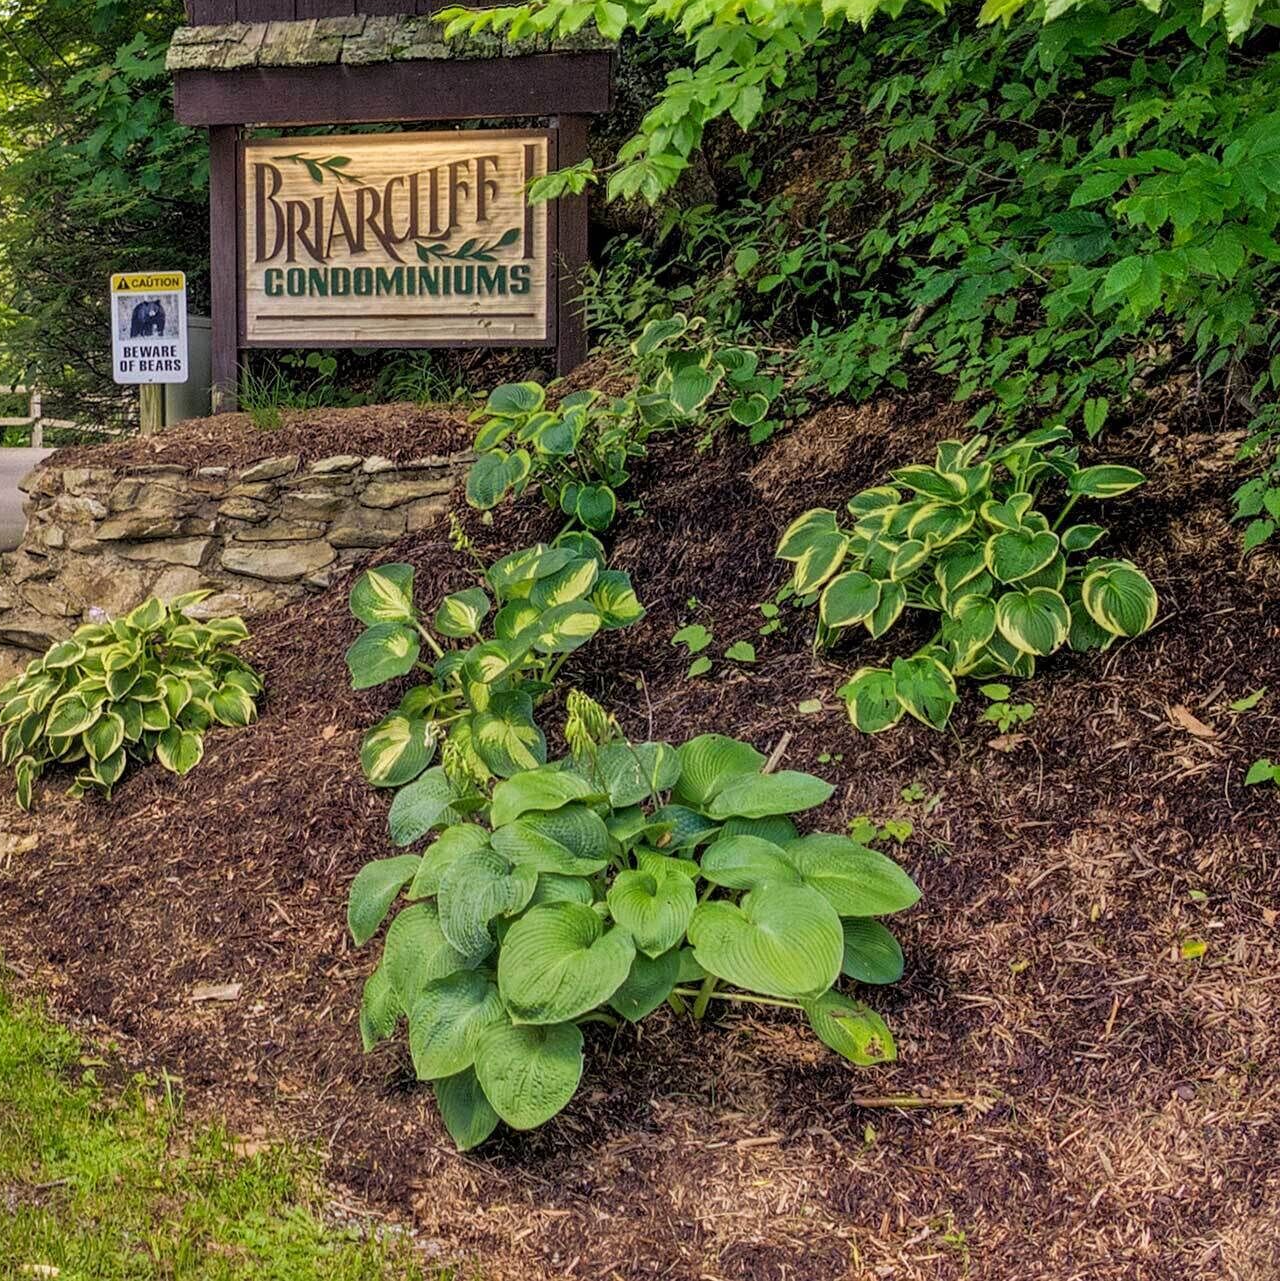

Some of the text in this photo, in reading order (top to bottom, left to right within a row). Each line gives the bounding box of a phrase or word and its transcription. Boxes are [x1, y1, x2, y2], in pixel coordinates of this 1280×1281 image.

[254, 154, 498, 264] BRIARCLIFF
[131, 278, 179, 288] CAUTION
[264, 265, 531, 297] CONDOMINIUMS
[123, 345, 177, 358] BEWARE
[120, 360, 181, 372] OF BEARS
